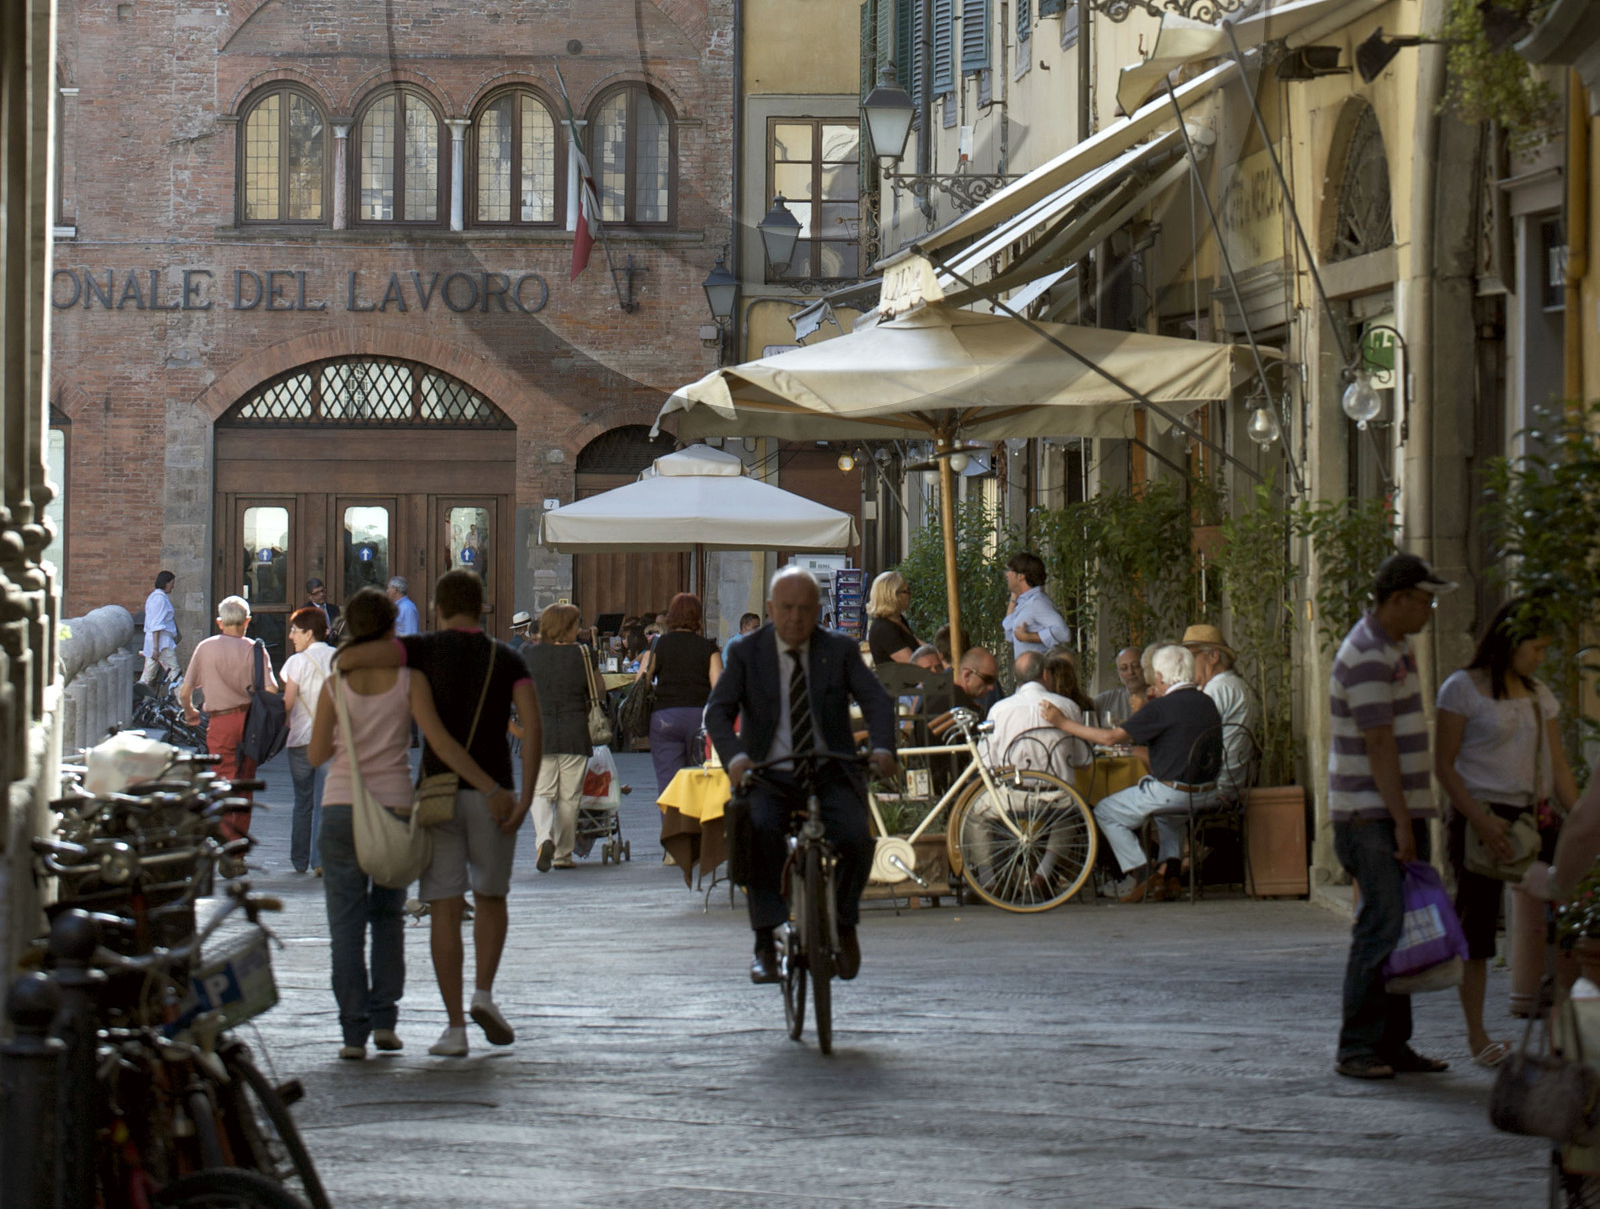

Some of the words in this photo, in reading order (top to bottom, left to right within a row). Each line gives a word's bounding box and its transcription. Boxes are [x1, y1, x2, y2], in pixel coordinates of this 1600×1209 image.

[233, 269, 326, 311] DEL
[347, 270, 549, 313] LAVORO
[203, 973, 230, 1008] P
